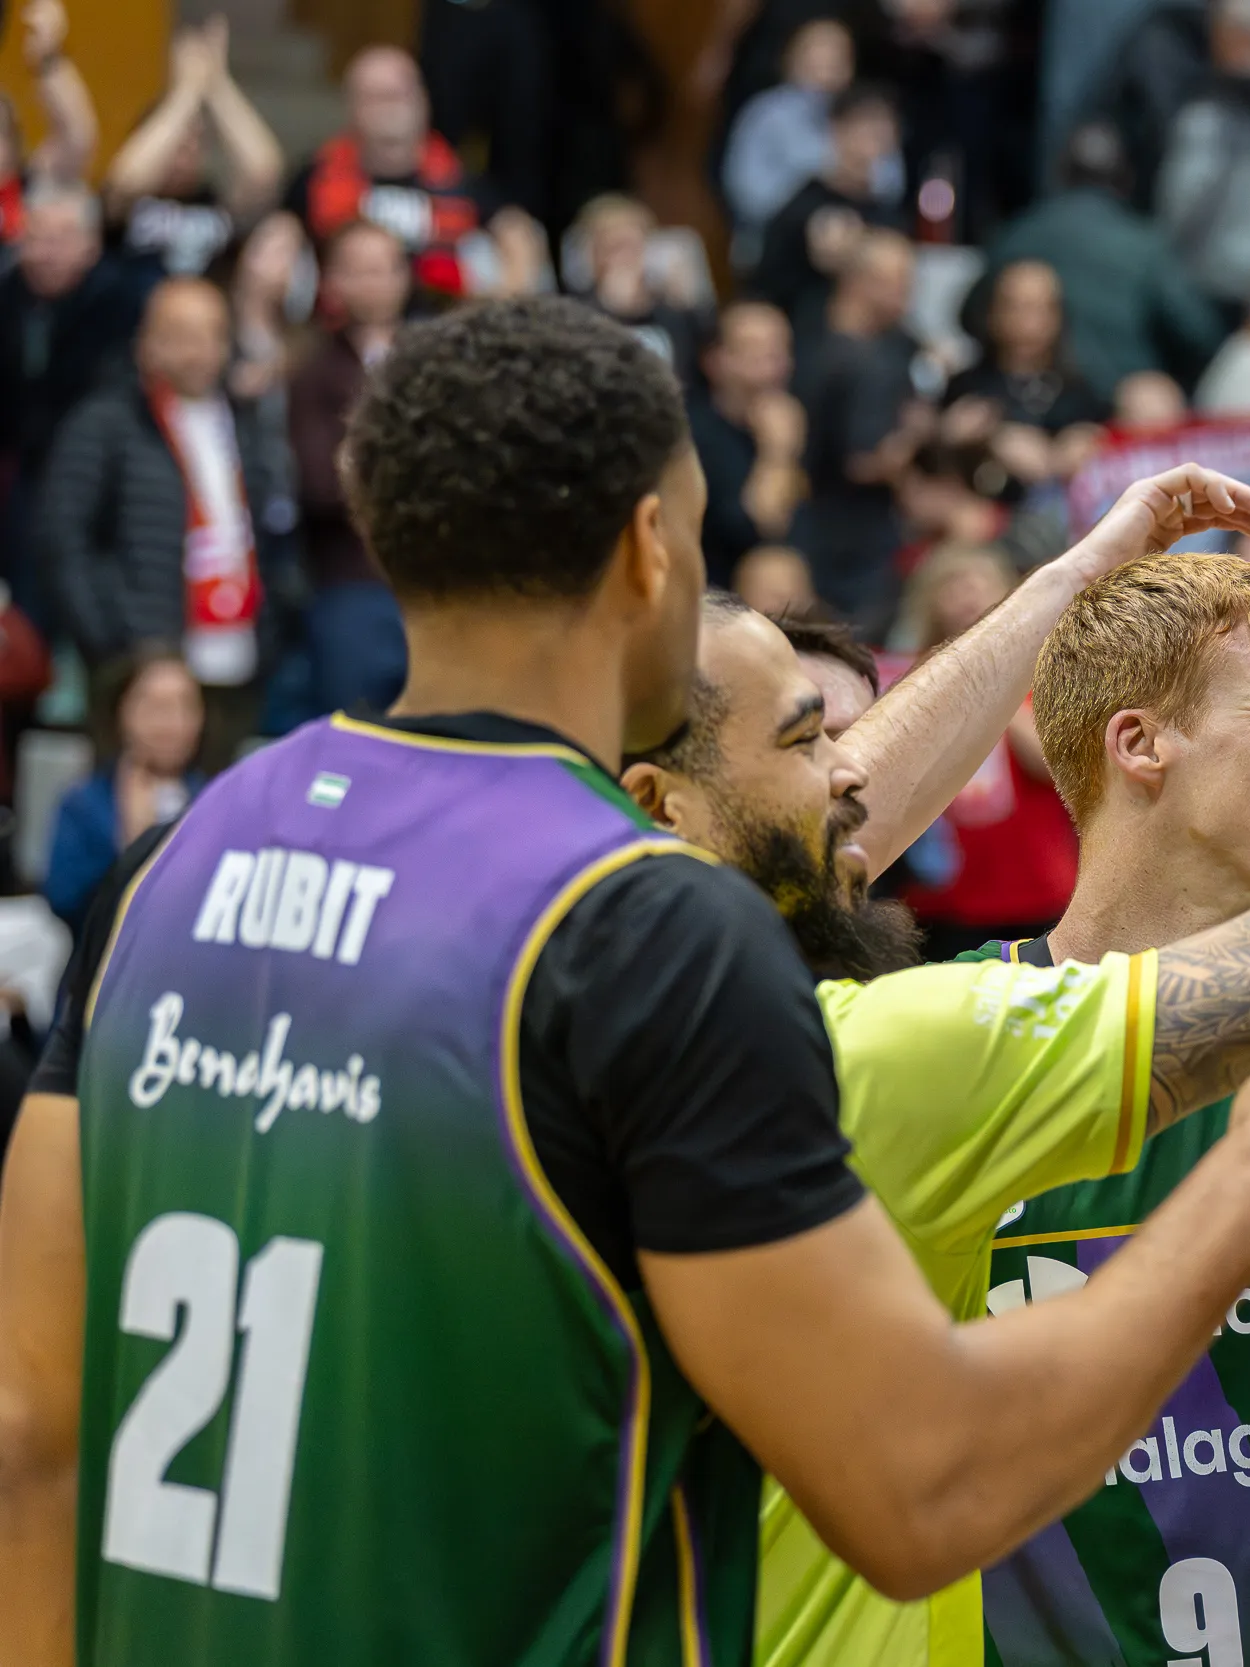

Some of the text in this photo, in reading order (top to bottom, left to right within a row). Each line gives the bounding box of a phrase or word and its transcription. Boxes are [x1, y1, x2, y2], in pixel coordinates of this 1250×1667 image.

[193, 847, 395, 966] RUBIT
[129, 992, 381, 1134] Benahavis
[102, 1211, 324, 1602] 21
[1159, 1557, 1244, 1667] 9
